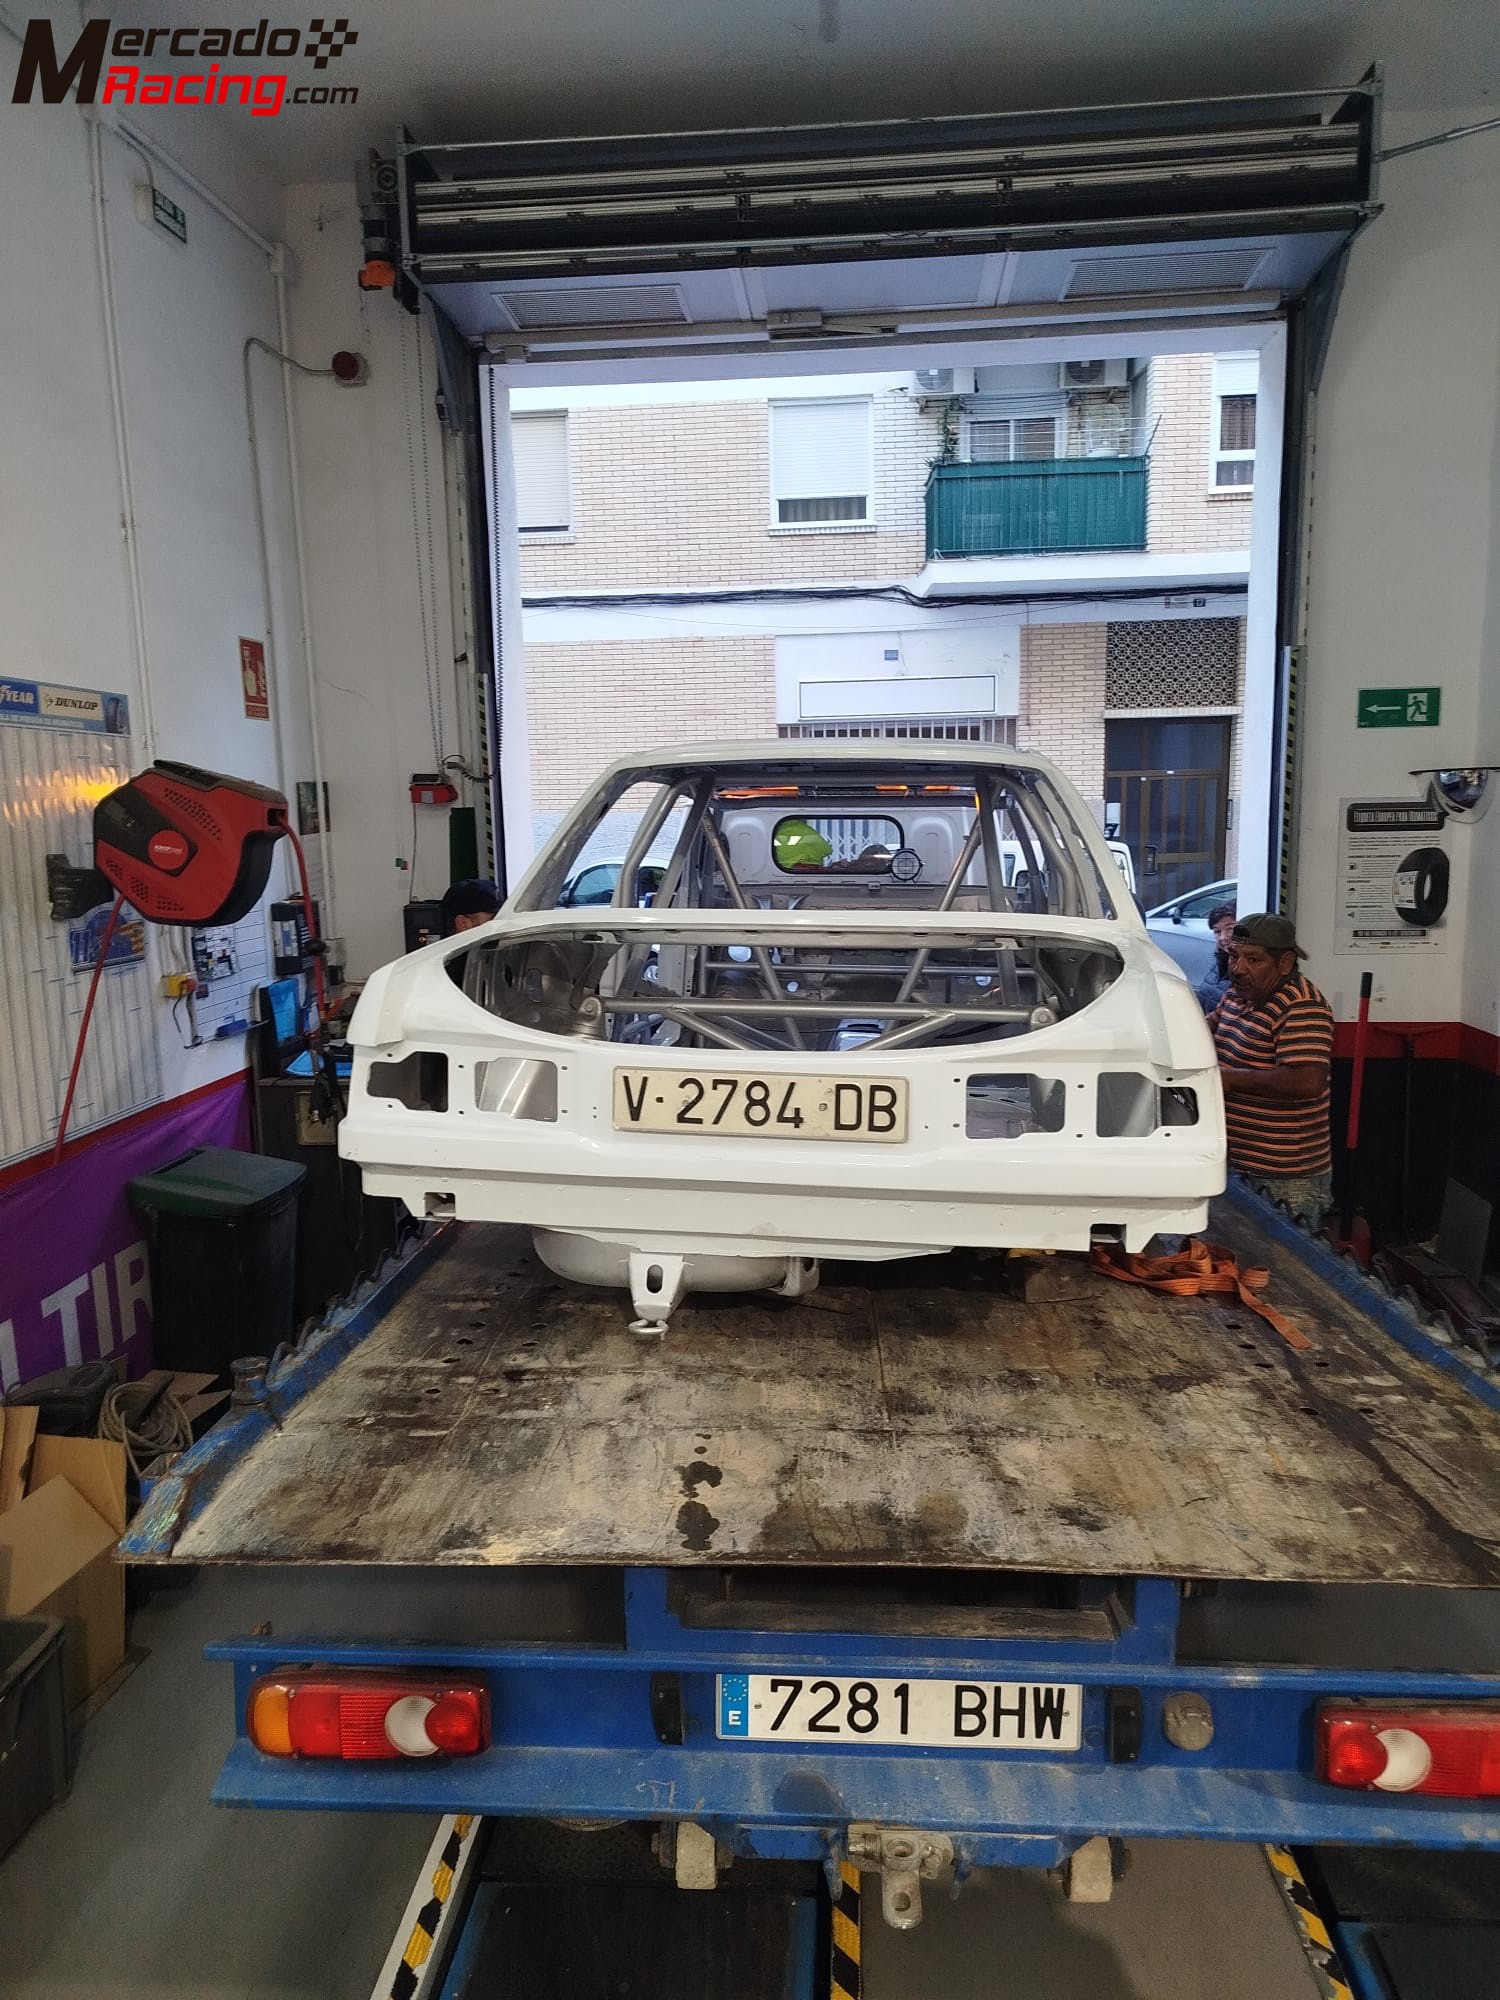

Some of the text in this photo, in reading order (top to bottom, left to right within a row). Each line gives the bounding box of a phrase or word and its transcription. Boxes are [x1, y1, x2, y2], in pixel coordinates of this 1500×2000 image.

[54, 697, 98, 711] DUNLOP
[834, 1083, 897, 1133] DB
[729, 1679, 1066, 1740] E 7281 BHW
